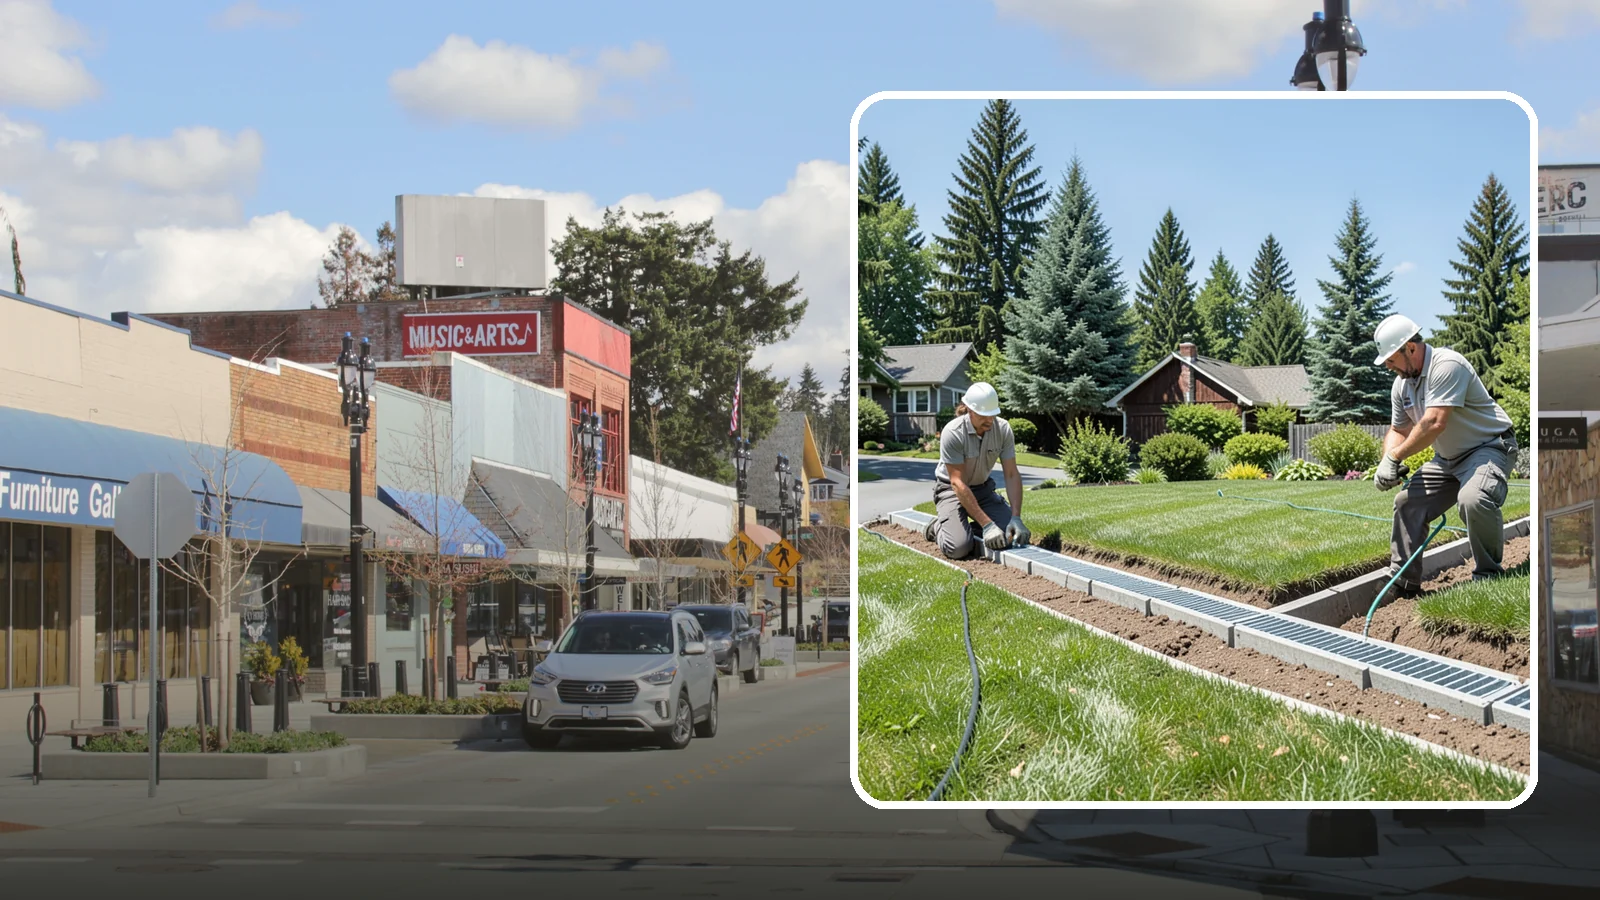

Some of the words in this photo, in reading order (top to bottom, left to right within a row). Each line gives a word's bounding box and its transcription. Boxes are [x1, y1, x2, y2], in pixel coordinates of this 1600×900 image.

[0, 471, 80, 516] Furniture
[89, 482, 122, 520] Gal
[453, 563, 480, 575] SUSHI
